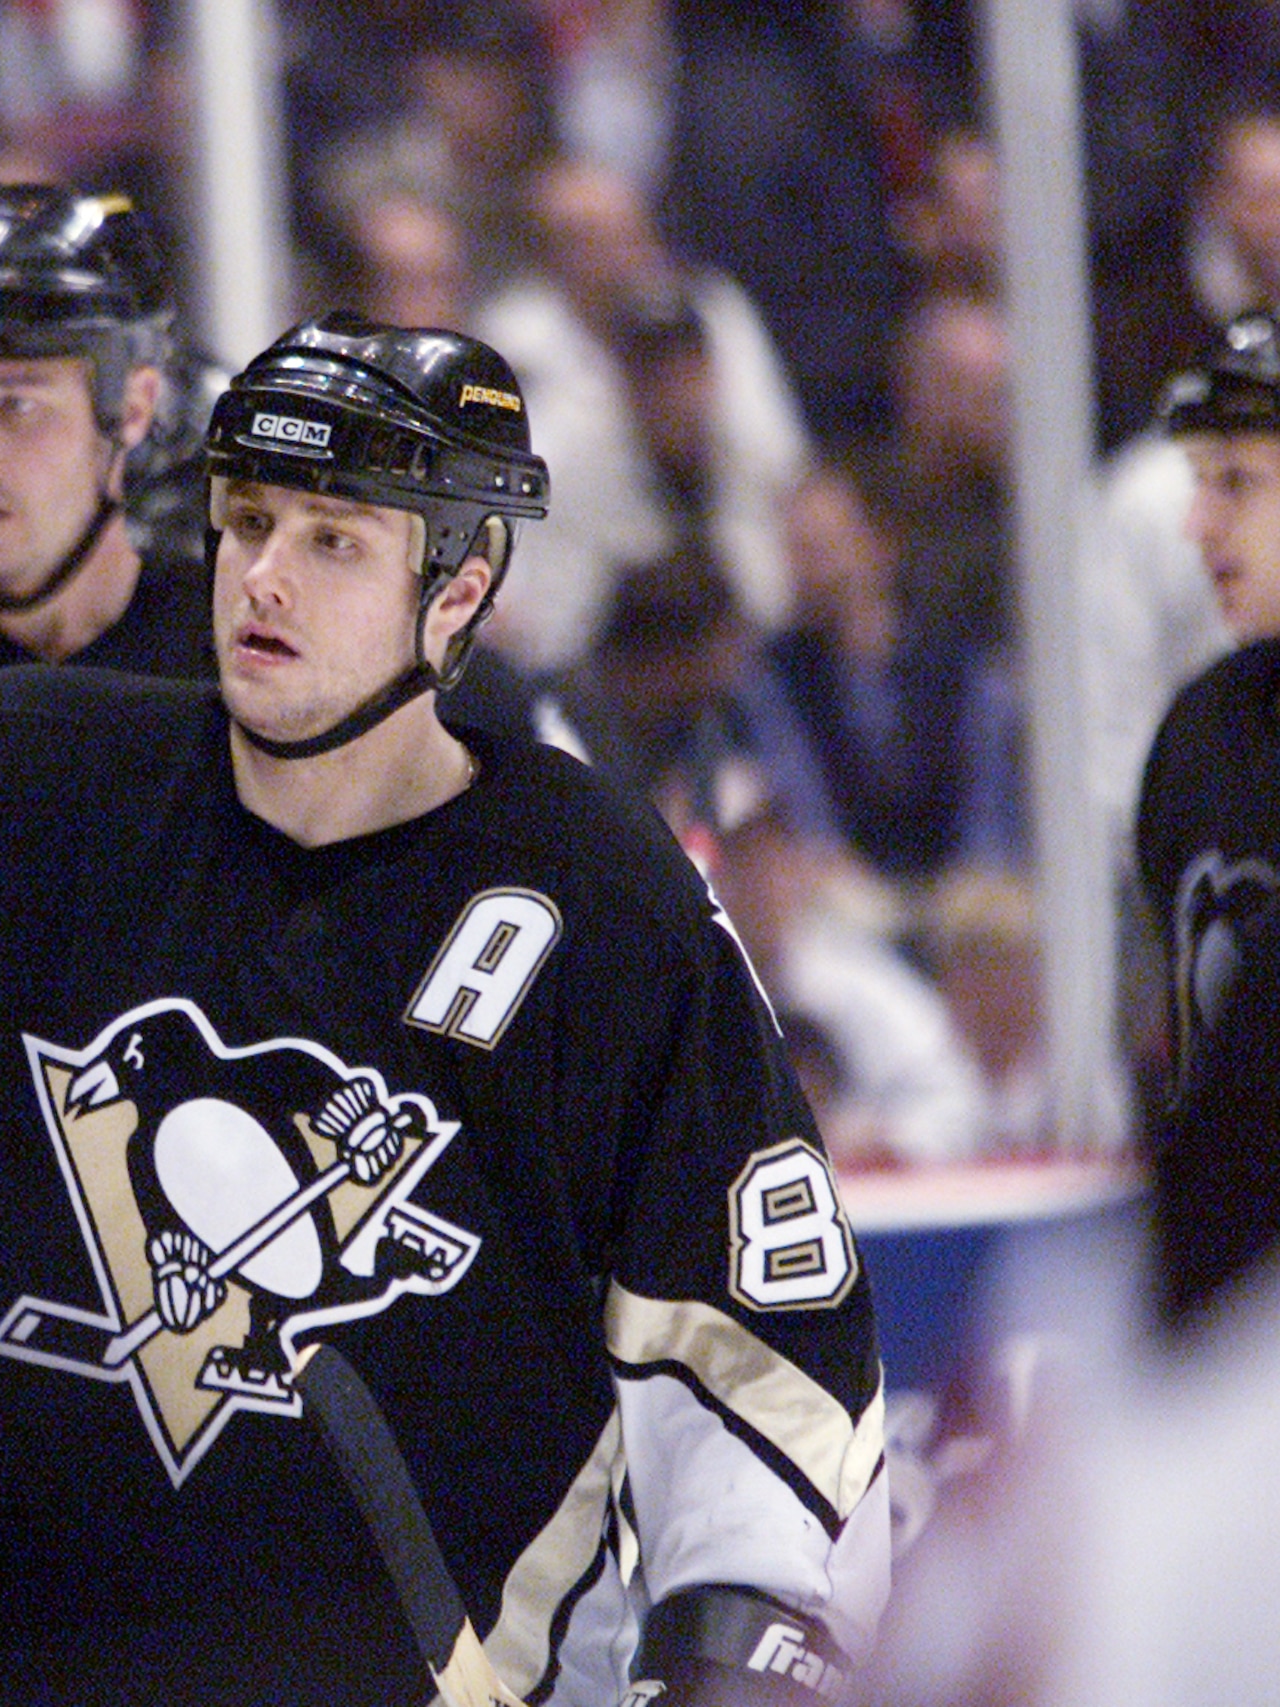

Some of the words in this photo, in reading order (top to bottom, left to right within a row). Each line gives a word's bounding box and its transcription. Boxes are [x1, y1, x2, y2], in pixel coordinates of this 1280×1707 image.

[258, 417, 328, 442] CCM
[402, 886, 563, 1050] A
[727, 1138, 859, 1311] 8
